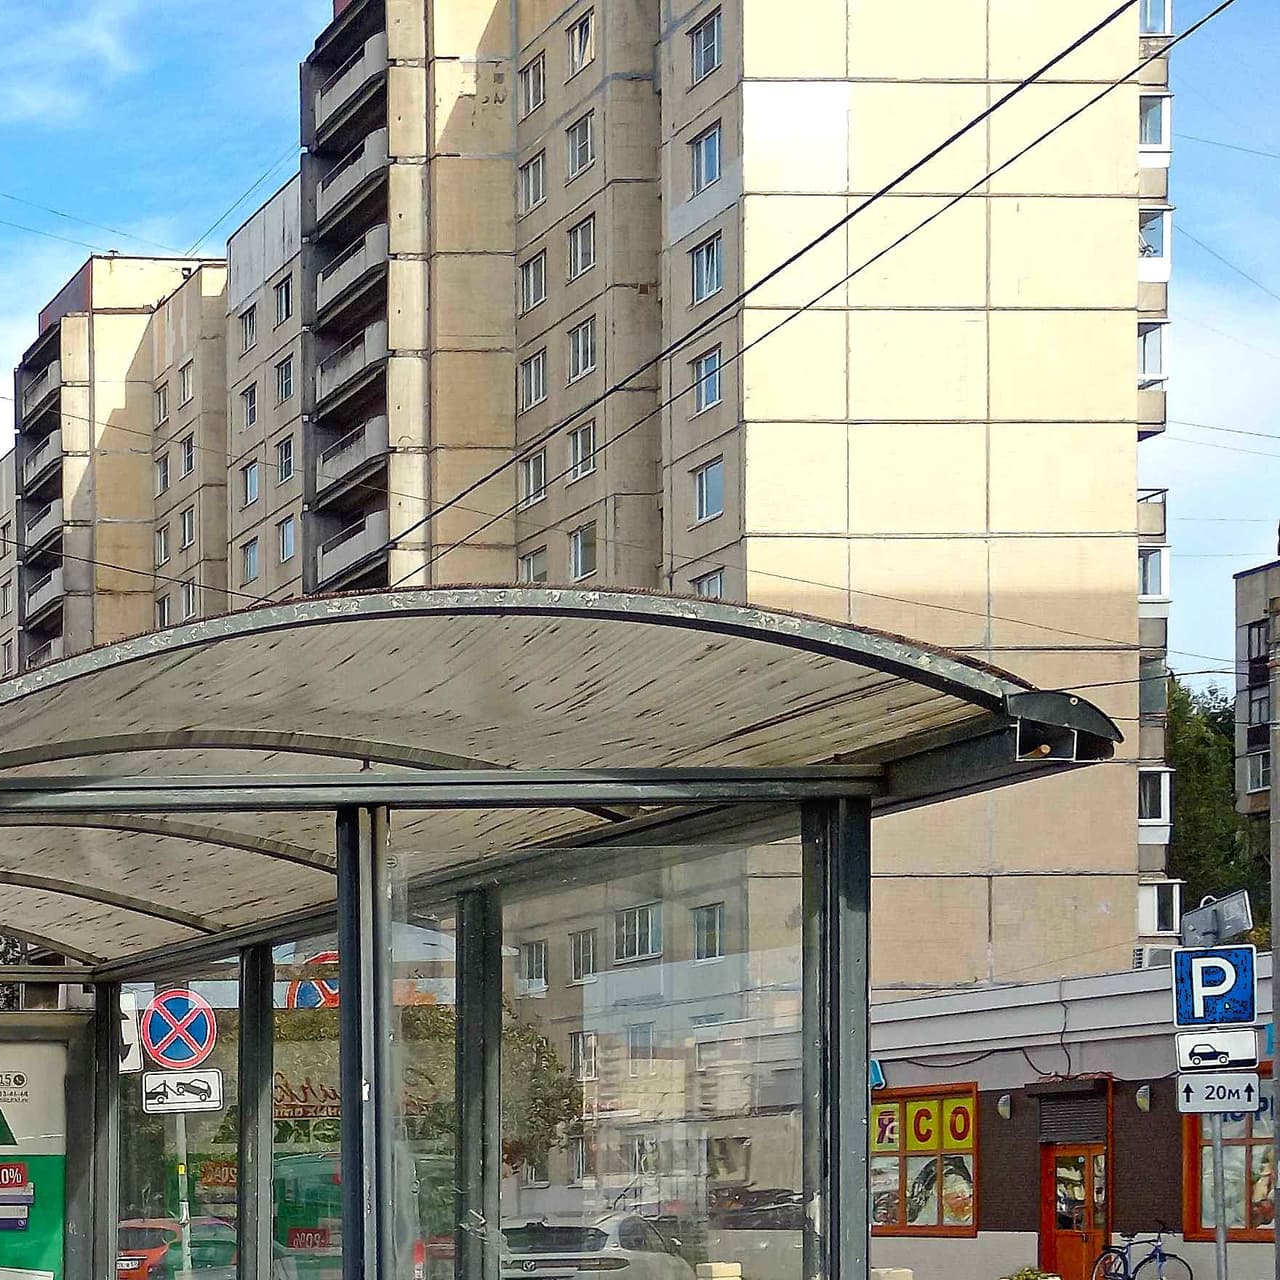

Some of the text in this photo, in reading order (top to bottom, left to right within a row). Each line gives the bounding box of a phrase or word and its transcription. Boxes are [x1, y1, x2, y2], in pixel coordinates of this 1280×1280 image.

[1191, 957, 1237, 1019] P
[1204, 1085, 1242, 1101] 20м
[877, 1106, 970, 1144] ЯСО
